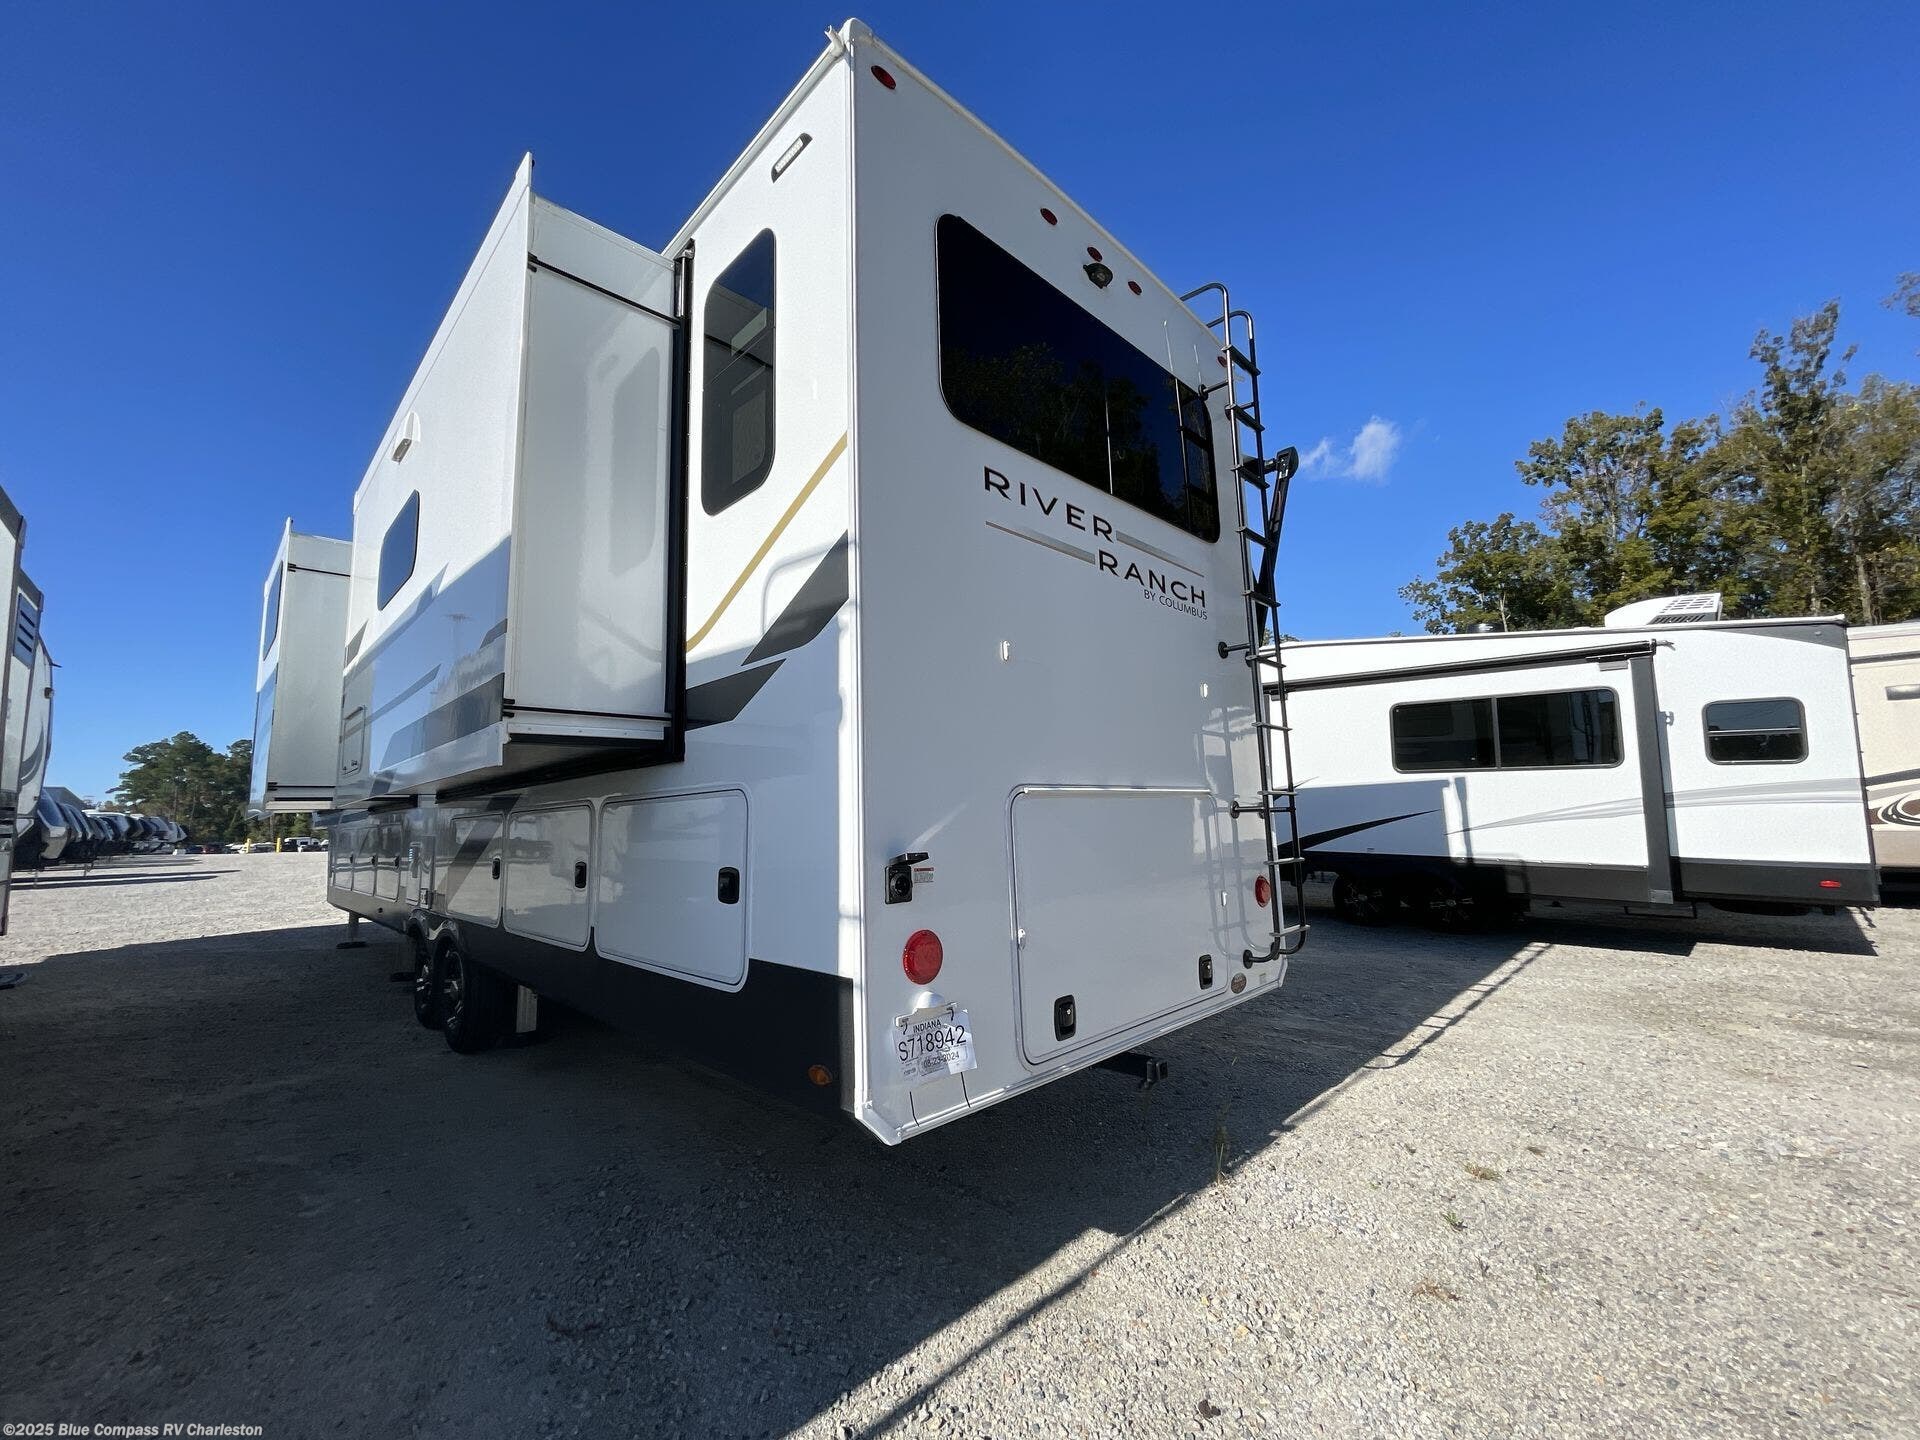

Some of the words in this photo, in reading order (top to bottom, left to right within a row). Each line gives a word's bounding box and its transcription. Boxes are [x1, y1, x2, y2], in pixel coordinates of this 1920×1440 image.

[984, 466, 1113, 543] RIVER
[1098, 549, 1206, 608] RANCH
[1144, 589, 1156, 600] BY
[1159, 596, 1208, 620] COLUMBUS
[898, 1025, 967, 1061] S718942
[913, 1019, 942, 1033] INDIANA
